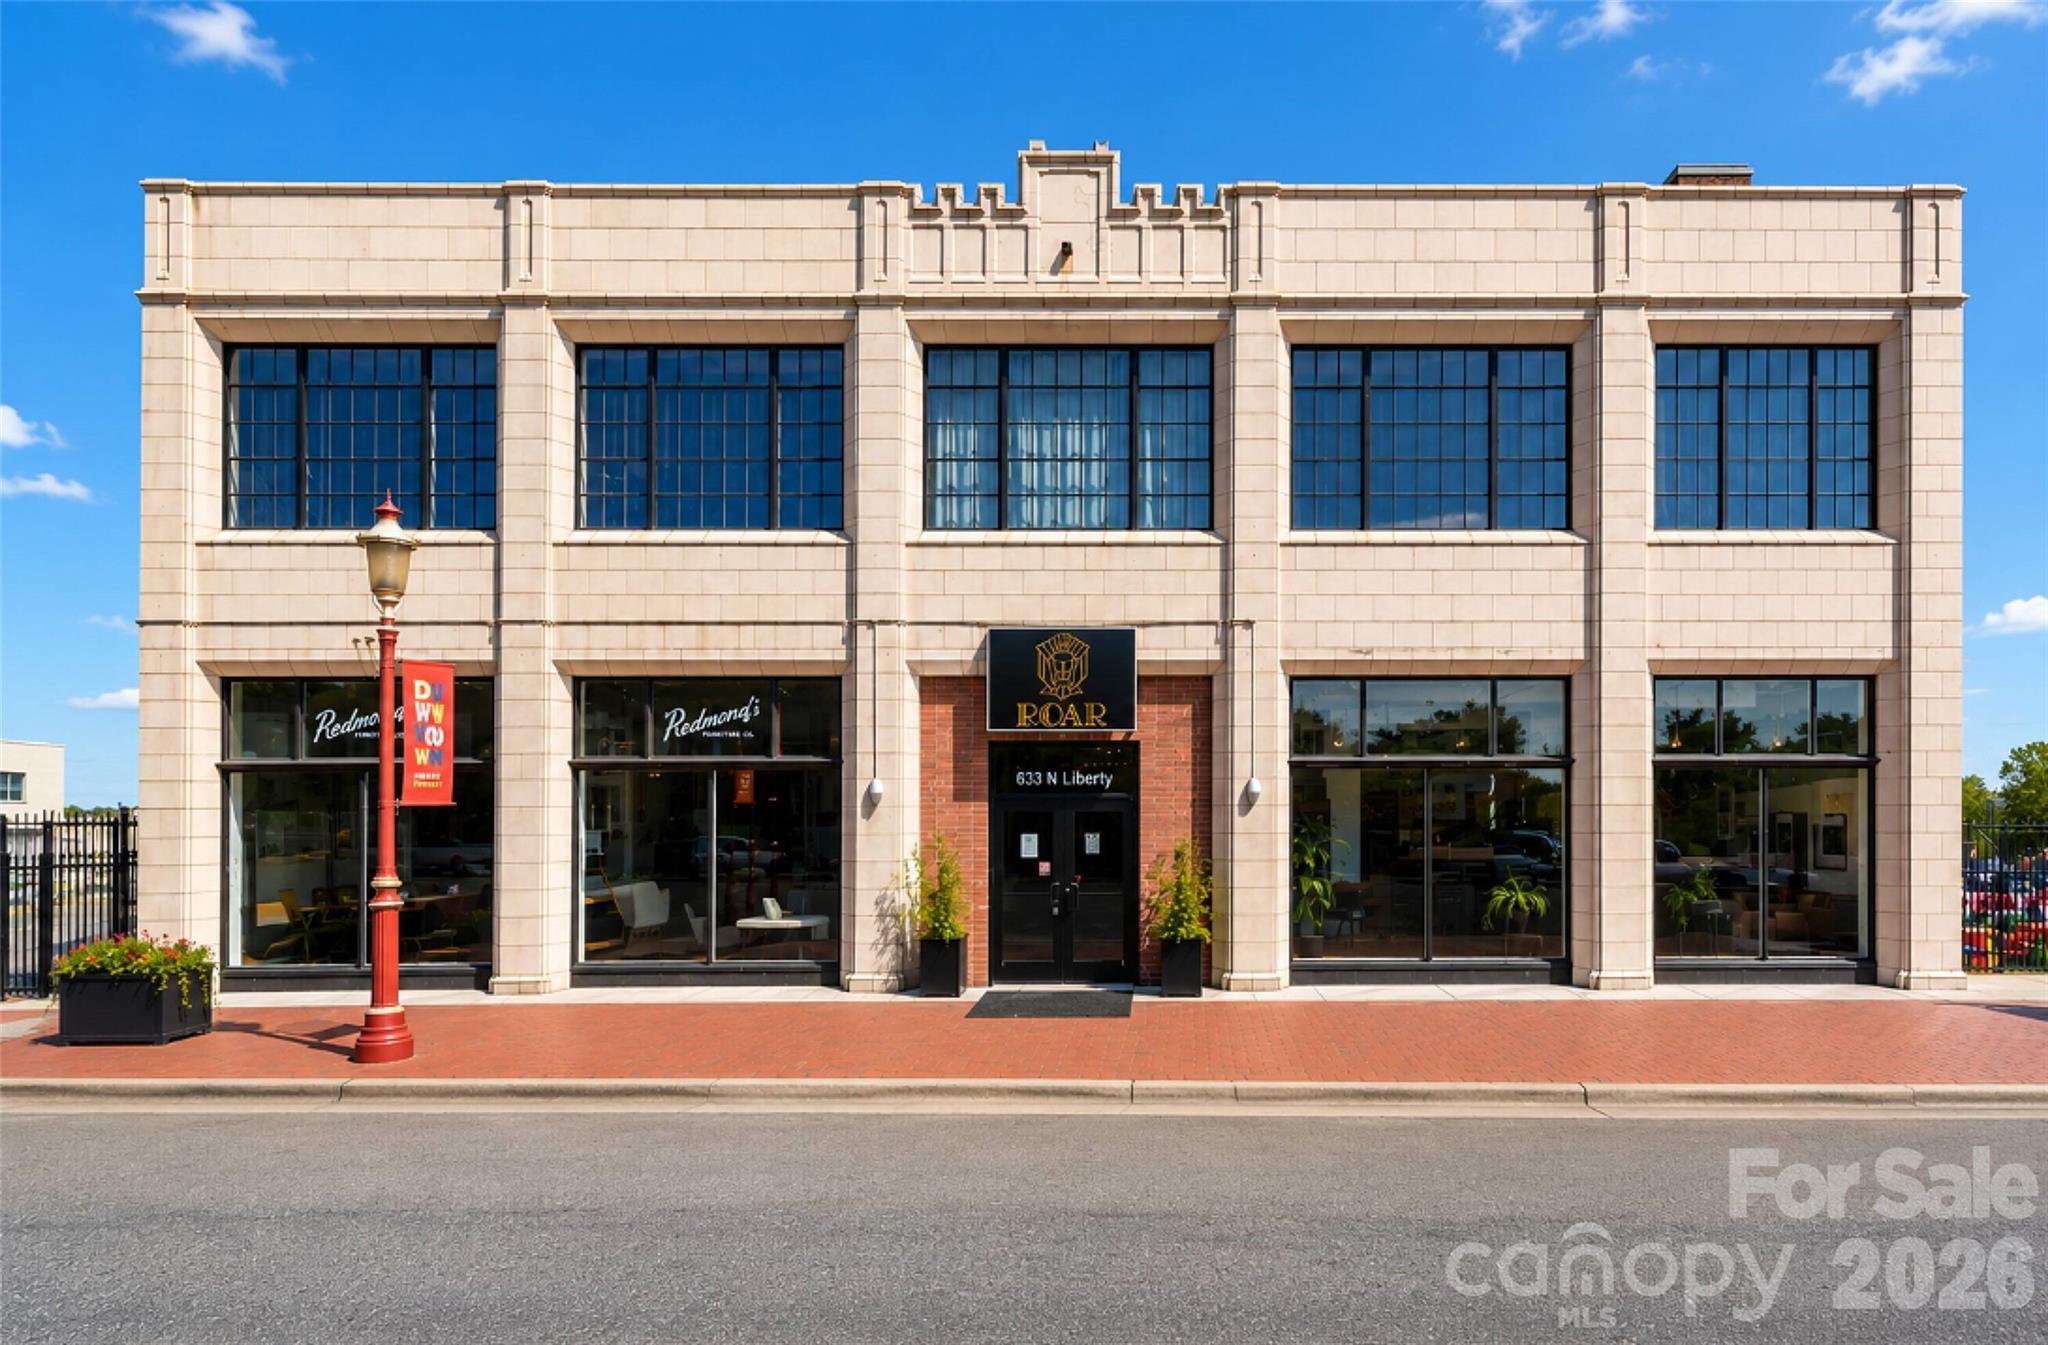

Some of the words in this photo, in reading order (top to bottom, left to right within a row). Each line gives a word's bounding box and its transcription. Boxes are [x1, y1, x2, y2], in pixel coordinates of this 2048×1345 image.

[663, 695, 760, 742] Redmond's
[1016, 702, 1107, 727] ROAR
[1016, 771, 1042, 786] 633
[1046, 771, 1057, 786] N
[1063, 771, 1113, 789] Liberty
